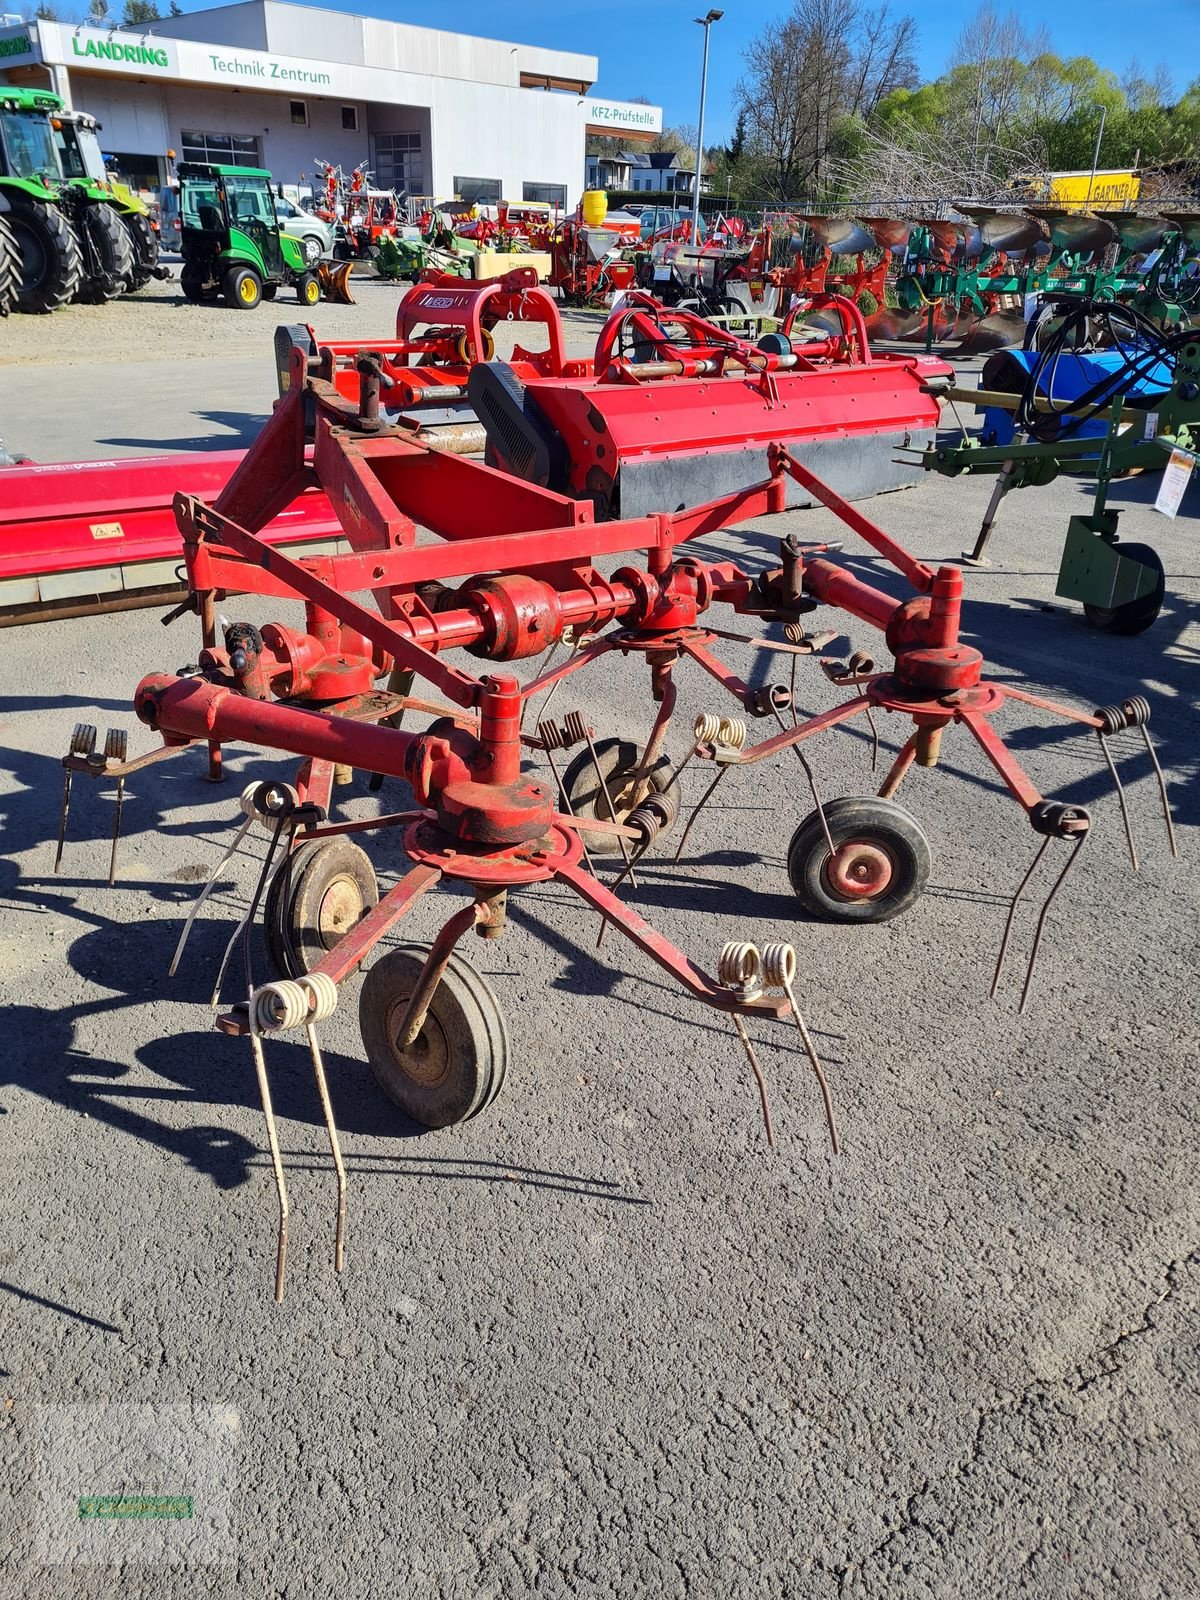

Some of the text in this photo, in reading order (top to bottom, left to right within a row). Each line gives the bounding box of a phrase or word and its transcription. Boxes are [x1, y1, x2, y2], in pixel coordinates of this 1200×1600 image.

[72, 37, 169, 67] LANDRING
[209, 55, 330, 84] Technik Zentrum
[592, 106, 655, 124] KFZ-Prüfstelle
